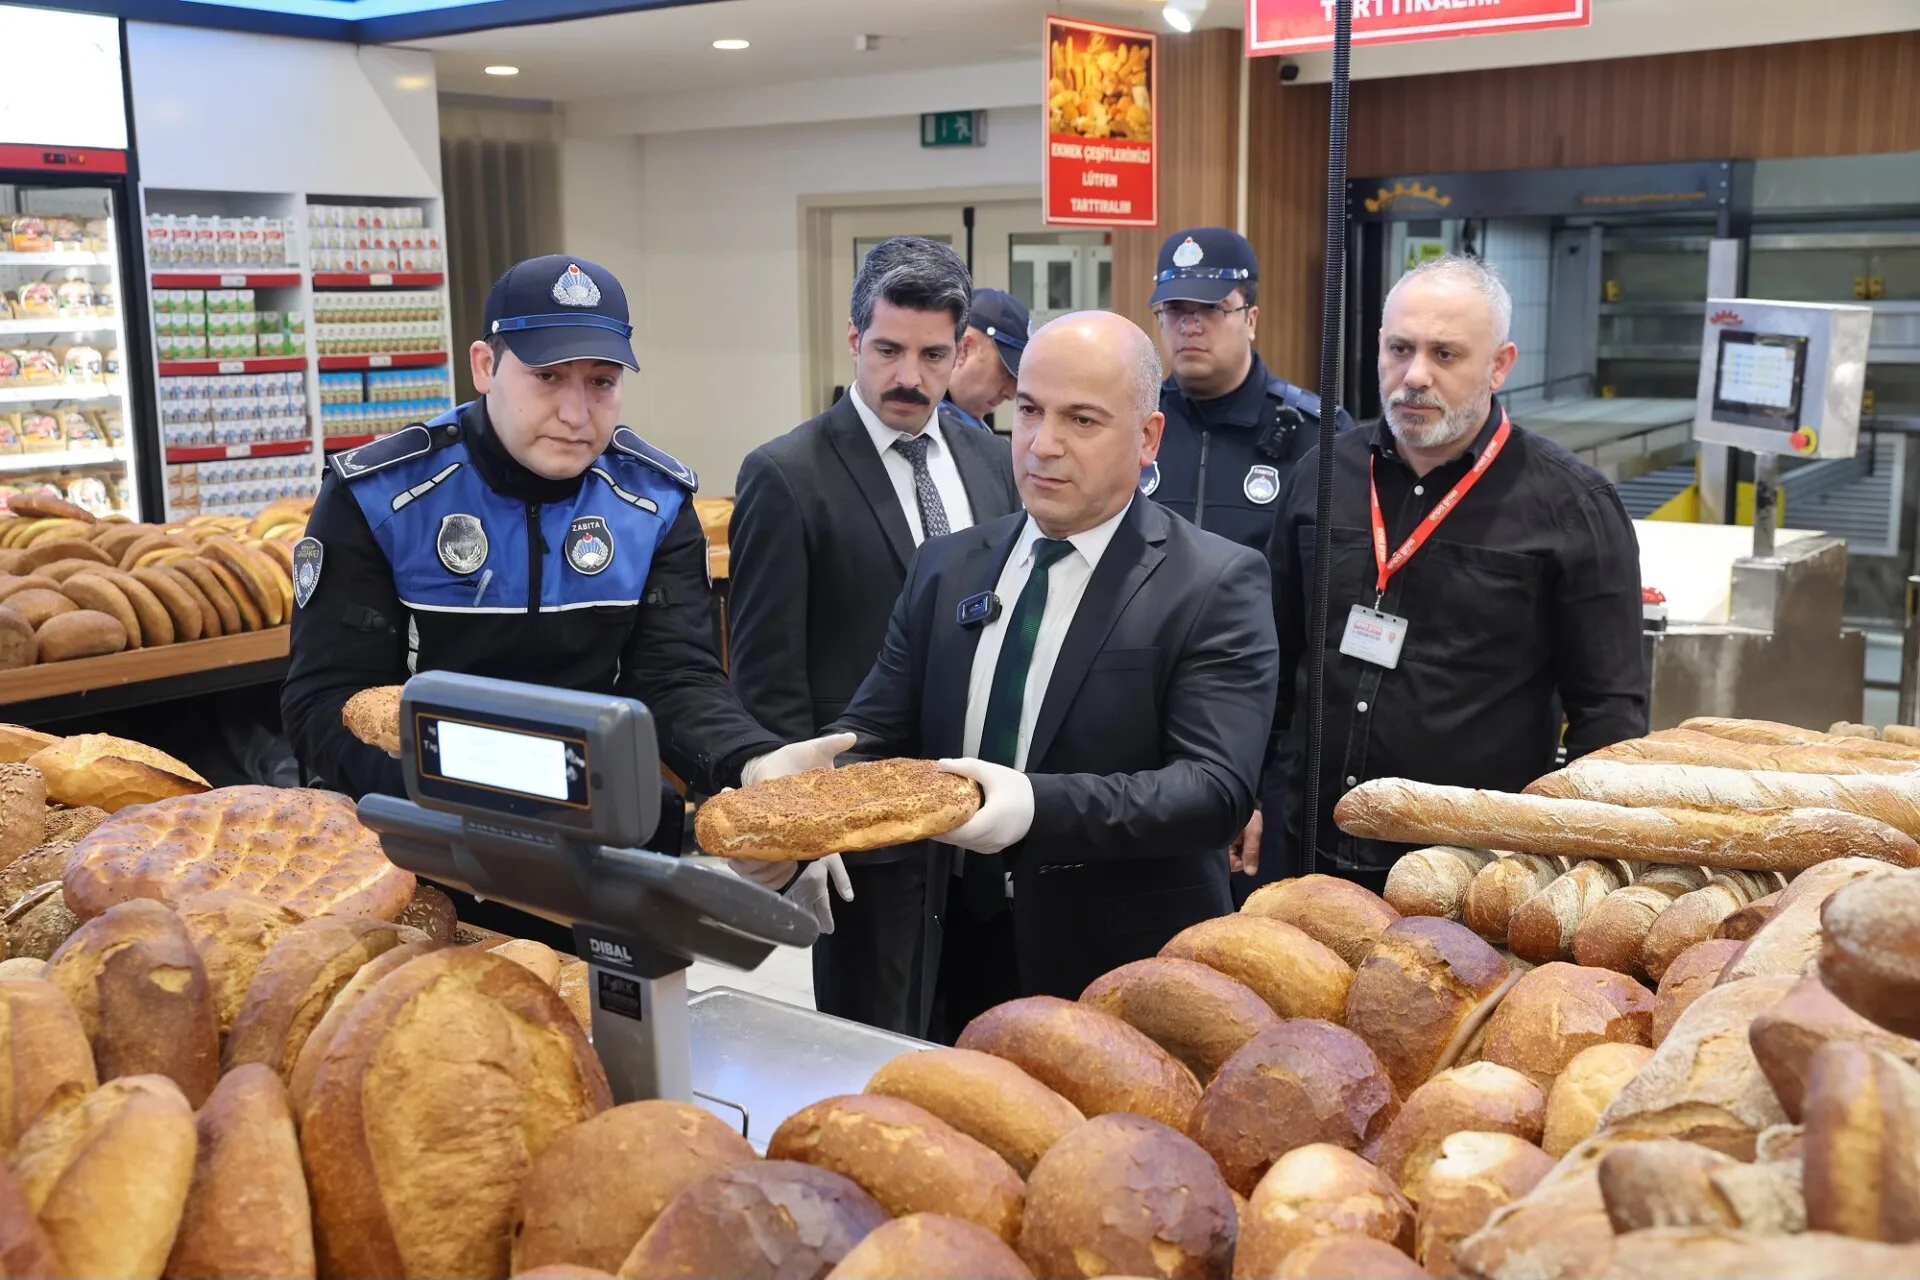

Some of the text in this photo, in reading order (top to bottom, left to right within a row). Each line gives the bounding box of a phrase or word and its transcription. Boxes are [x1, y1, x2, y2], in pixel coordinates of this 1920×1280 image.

[1320, 0, 1500, 22] TRTTIRA
[1082, 170, 1118, 188] LÜTFEN
[572, 522, 600, 531] ZABITA
[589, 938, 633, 961] DIBAL
